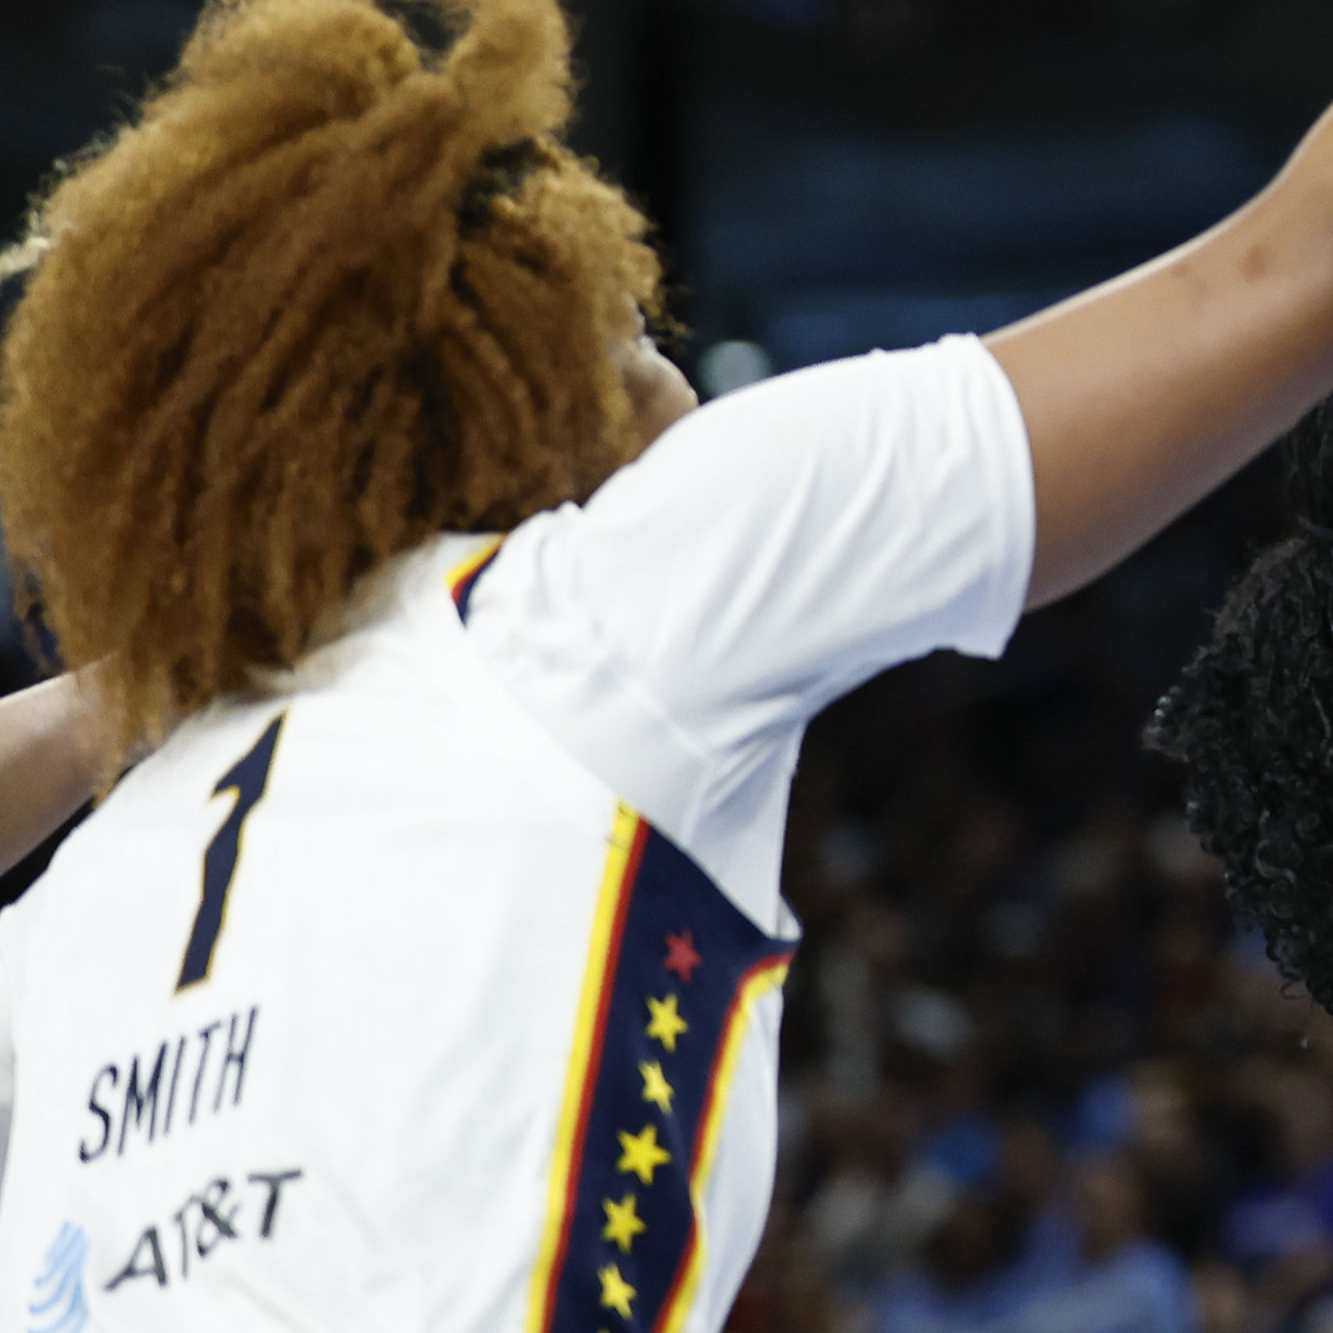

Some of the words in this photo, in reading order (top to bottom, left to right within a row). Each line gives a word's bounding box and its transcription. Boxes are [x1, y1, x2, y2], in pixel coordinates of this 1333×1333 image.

[172, 706, 289, 1001] 1
[79, 1004, 258, 1164] SMITH
[104, 1167, 304, 1292] AT&T
